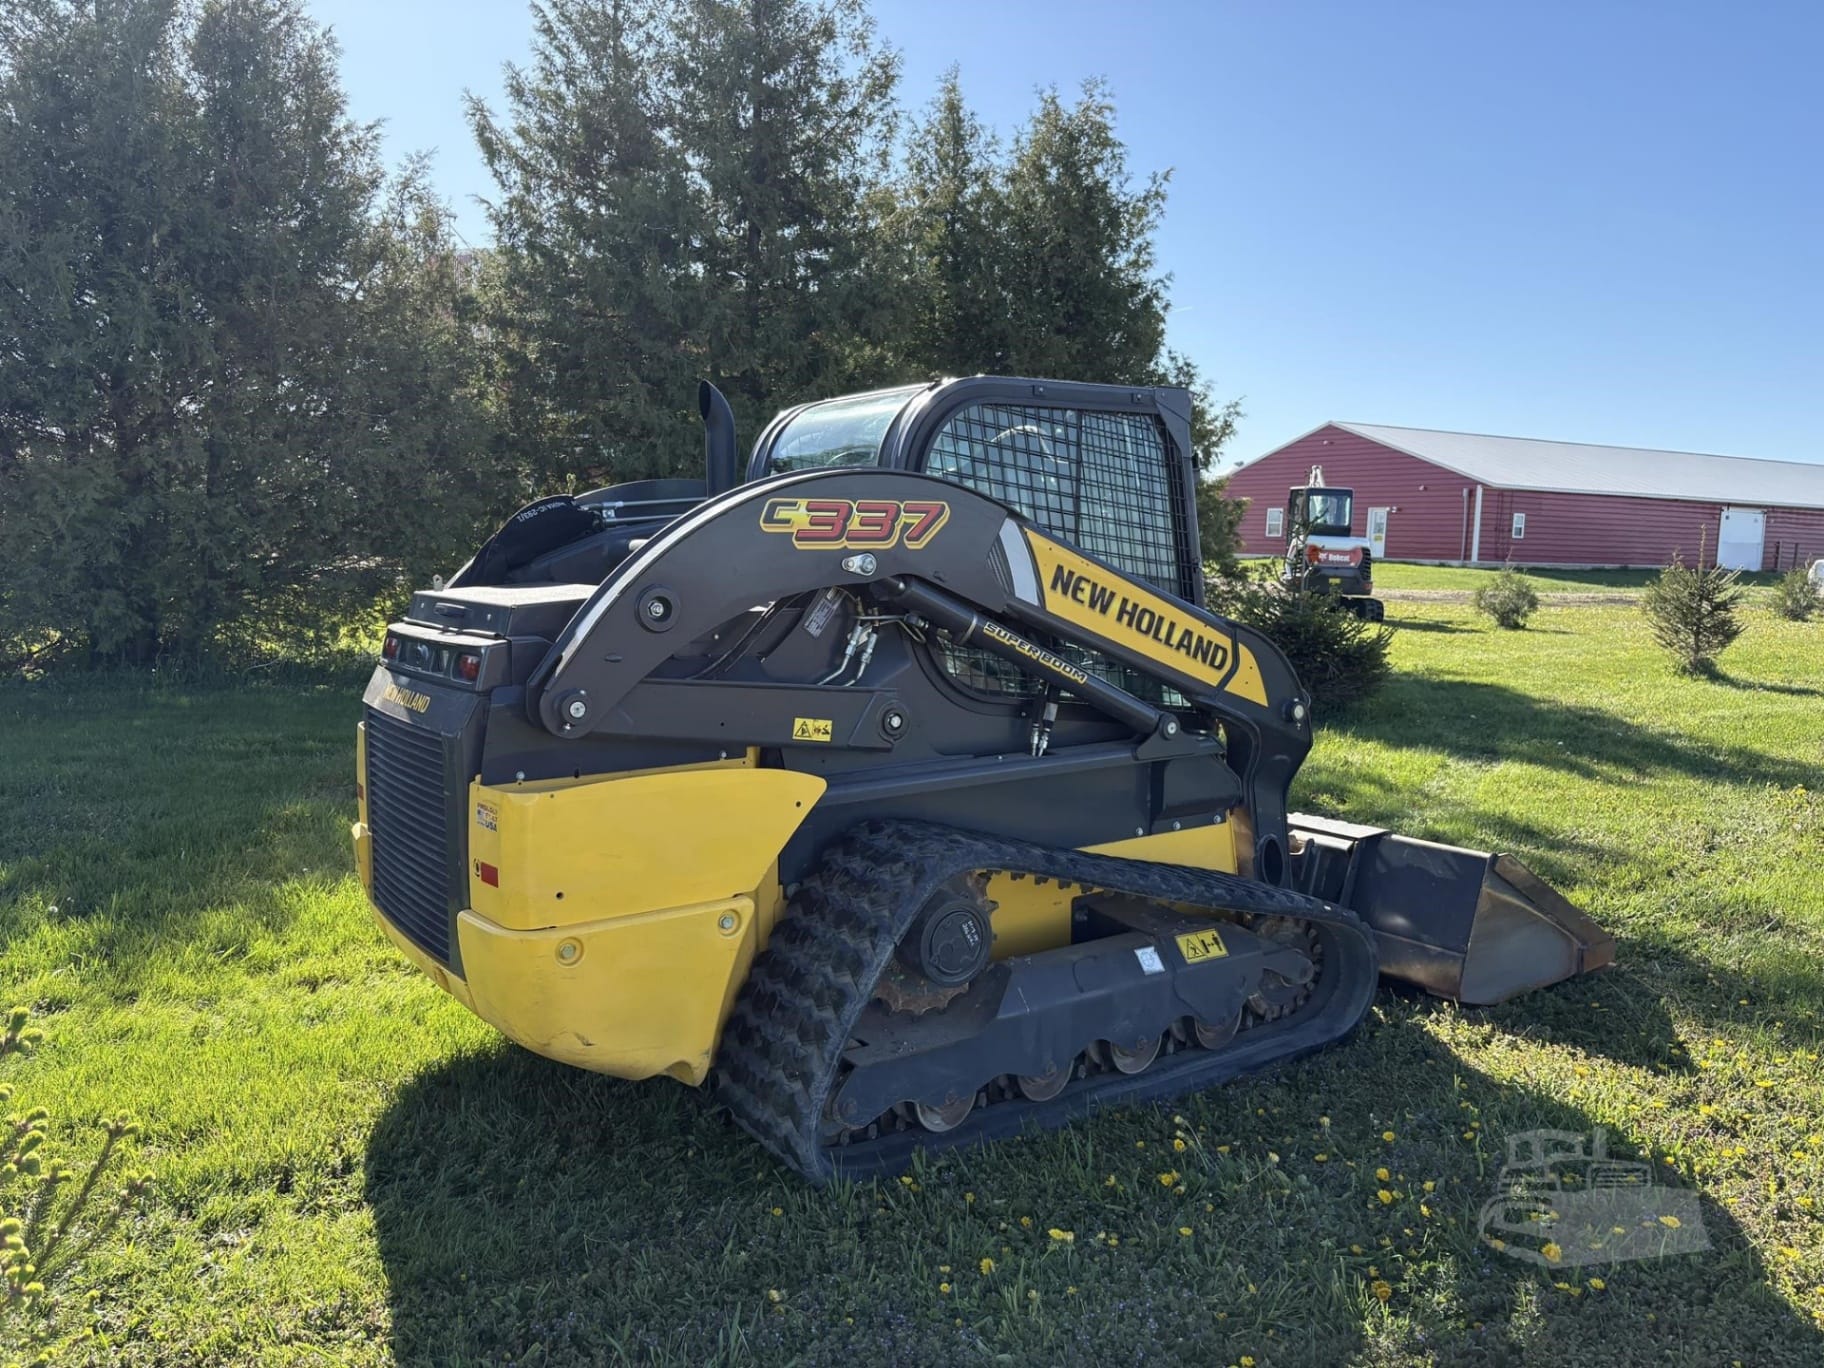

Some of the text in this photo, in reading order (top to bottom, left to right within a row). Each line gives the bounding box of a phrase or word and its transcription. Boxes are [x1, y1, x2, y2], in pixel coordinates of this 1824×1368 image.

[760, 498, 951, 550] C337
[1328, 553, 1350, 562] Bobcat
[1050, 564, 1228, 671] NEW HOLLAND
[983, 621, 1088, 684] SUPER BOOM
[397, 687, 431, 713] HOLLAND
